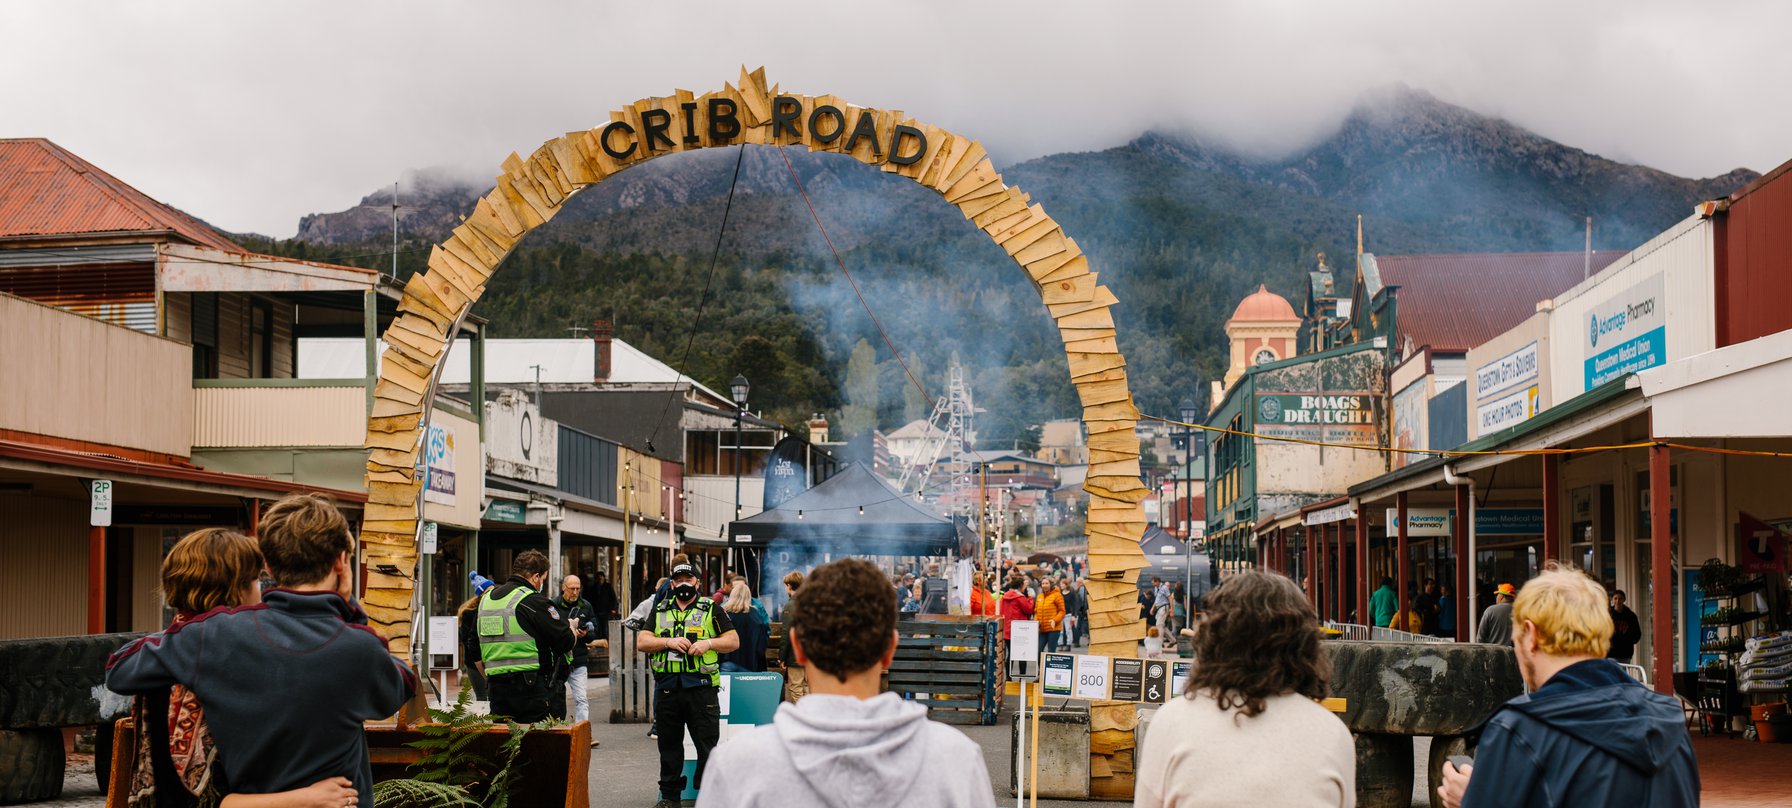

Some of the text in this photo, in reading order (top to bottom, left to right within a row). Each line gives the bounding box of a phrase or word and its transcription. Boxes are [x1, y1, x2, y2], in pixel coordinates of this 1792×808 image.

[600, 96, 928, 165] CRIB ROAD
[1599, 296, 1656, 336] Advantage Pharmacy
[1595, 337, 1651, 373] Queenstown Medical Union
[1478, 369, 1501, 393] QUEENSTOWN
[1501, 361, 1512, 383] GIFTS
[1516, 351, 1536, 377] SOUVENIRS
[1301, 395, 1361, 409] BOAGS
[1483, 399, 1523, 428] ONE HOUR PHOTOS
[1284, 409, 1373, 423] DRAUGHT
[520, 410, 532, 461] Q
[94, 481, 110, 493] 2P
[424, 524, 436, 532] 2P
[1500, 514, 1530, 522] Medical
[1531, 514, 1545, 522] Uni
[1753, 530, 1774, 554] T
[1080, 674, 1104, 687] 800
